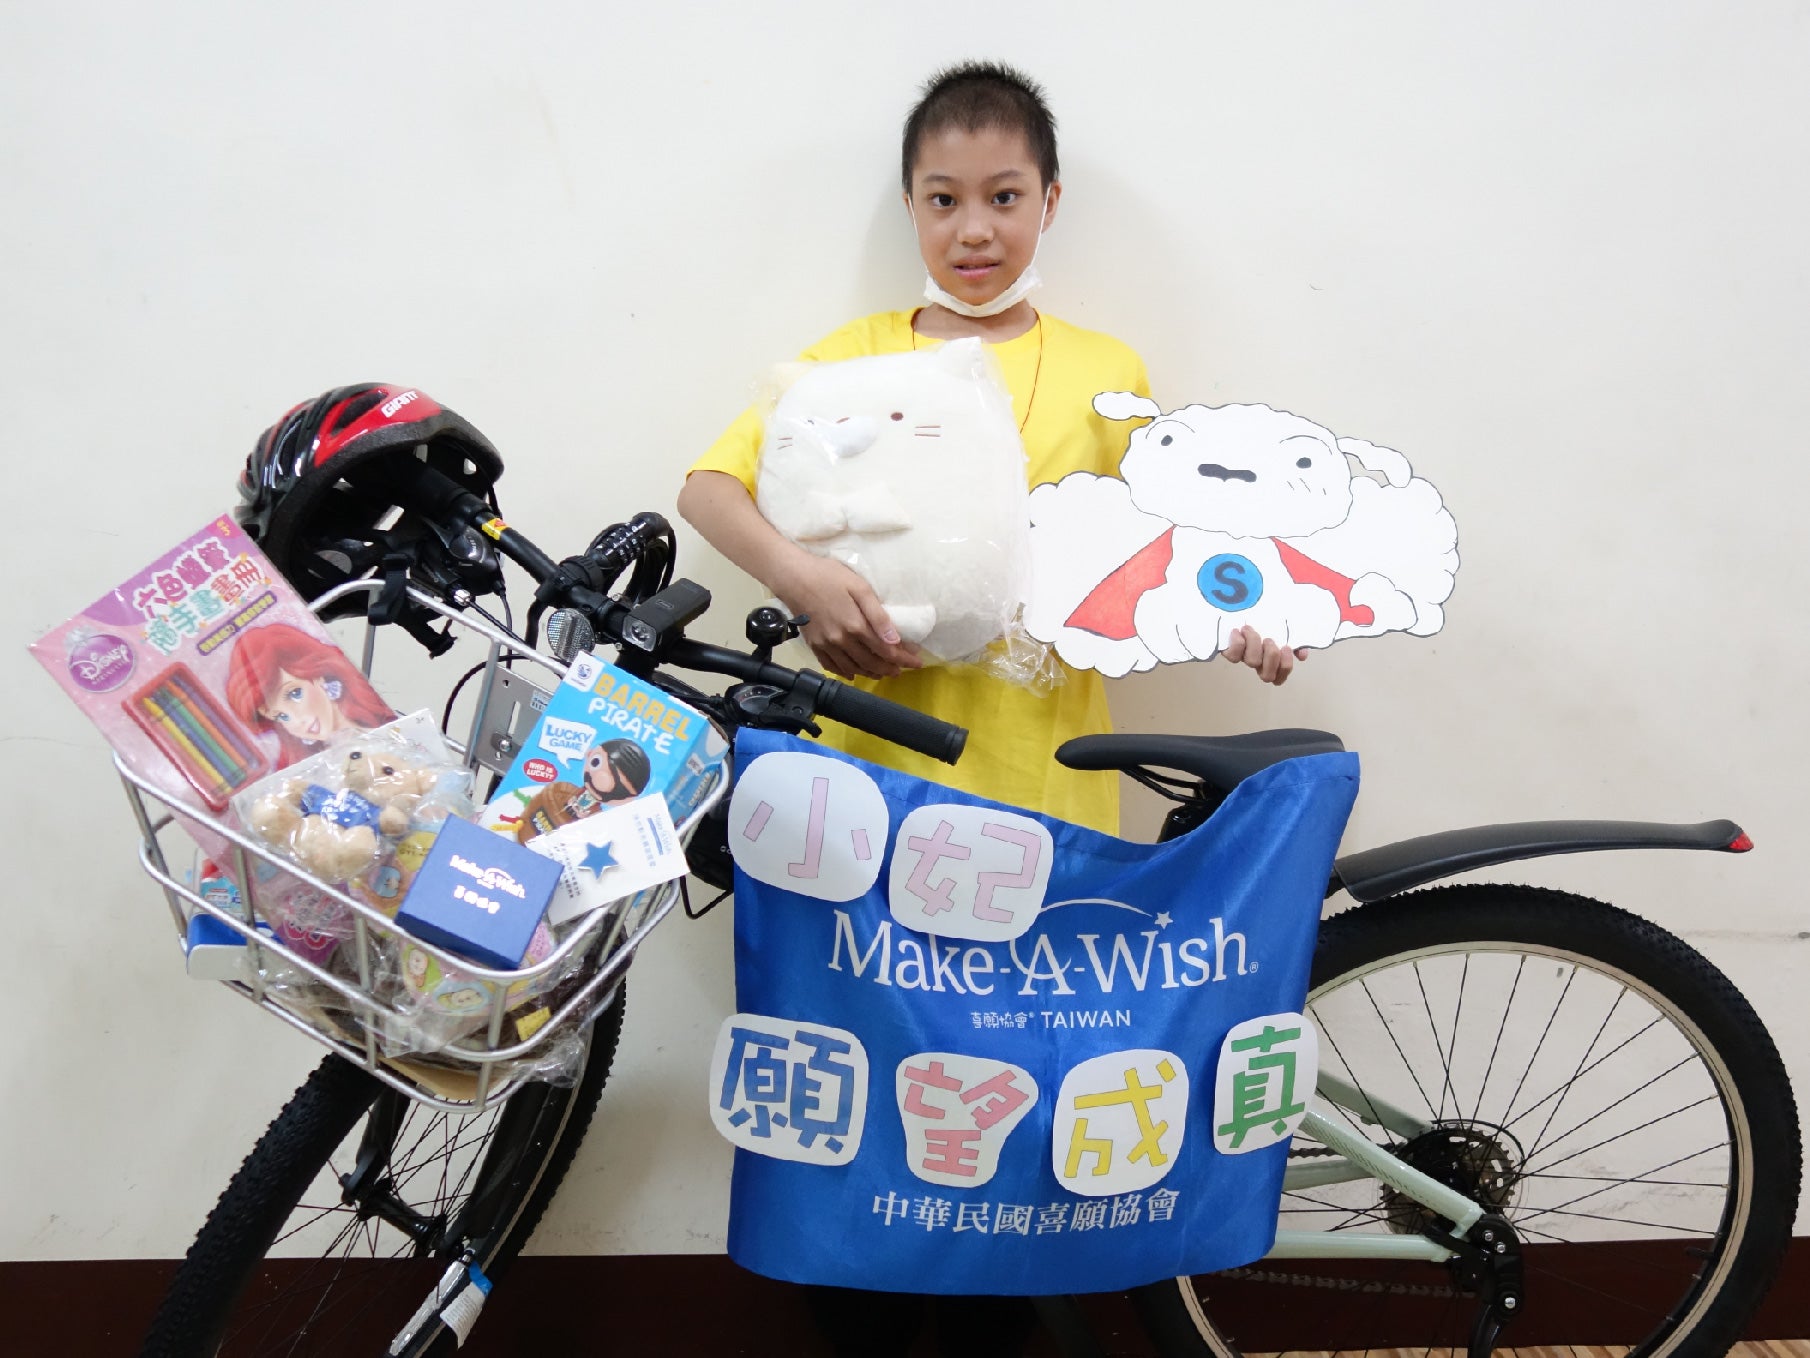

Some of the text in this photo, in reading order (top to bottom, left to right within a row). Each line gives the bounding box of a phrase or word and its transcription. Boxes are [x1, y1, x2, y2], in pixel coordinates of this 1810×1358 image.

[1212, 561, 1249, 604] S
[588, 697, 675, 755] PIRATE
[594, 674, 692, 741] BARREL
[546, 725, 592, 743] LUCKY
[549, 738, 582, 752] GAME
[1041, 1009, 1131, 1029] TAIWAN
[872, 1187, 1181, 1236] 中華民國喜願協會
